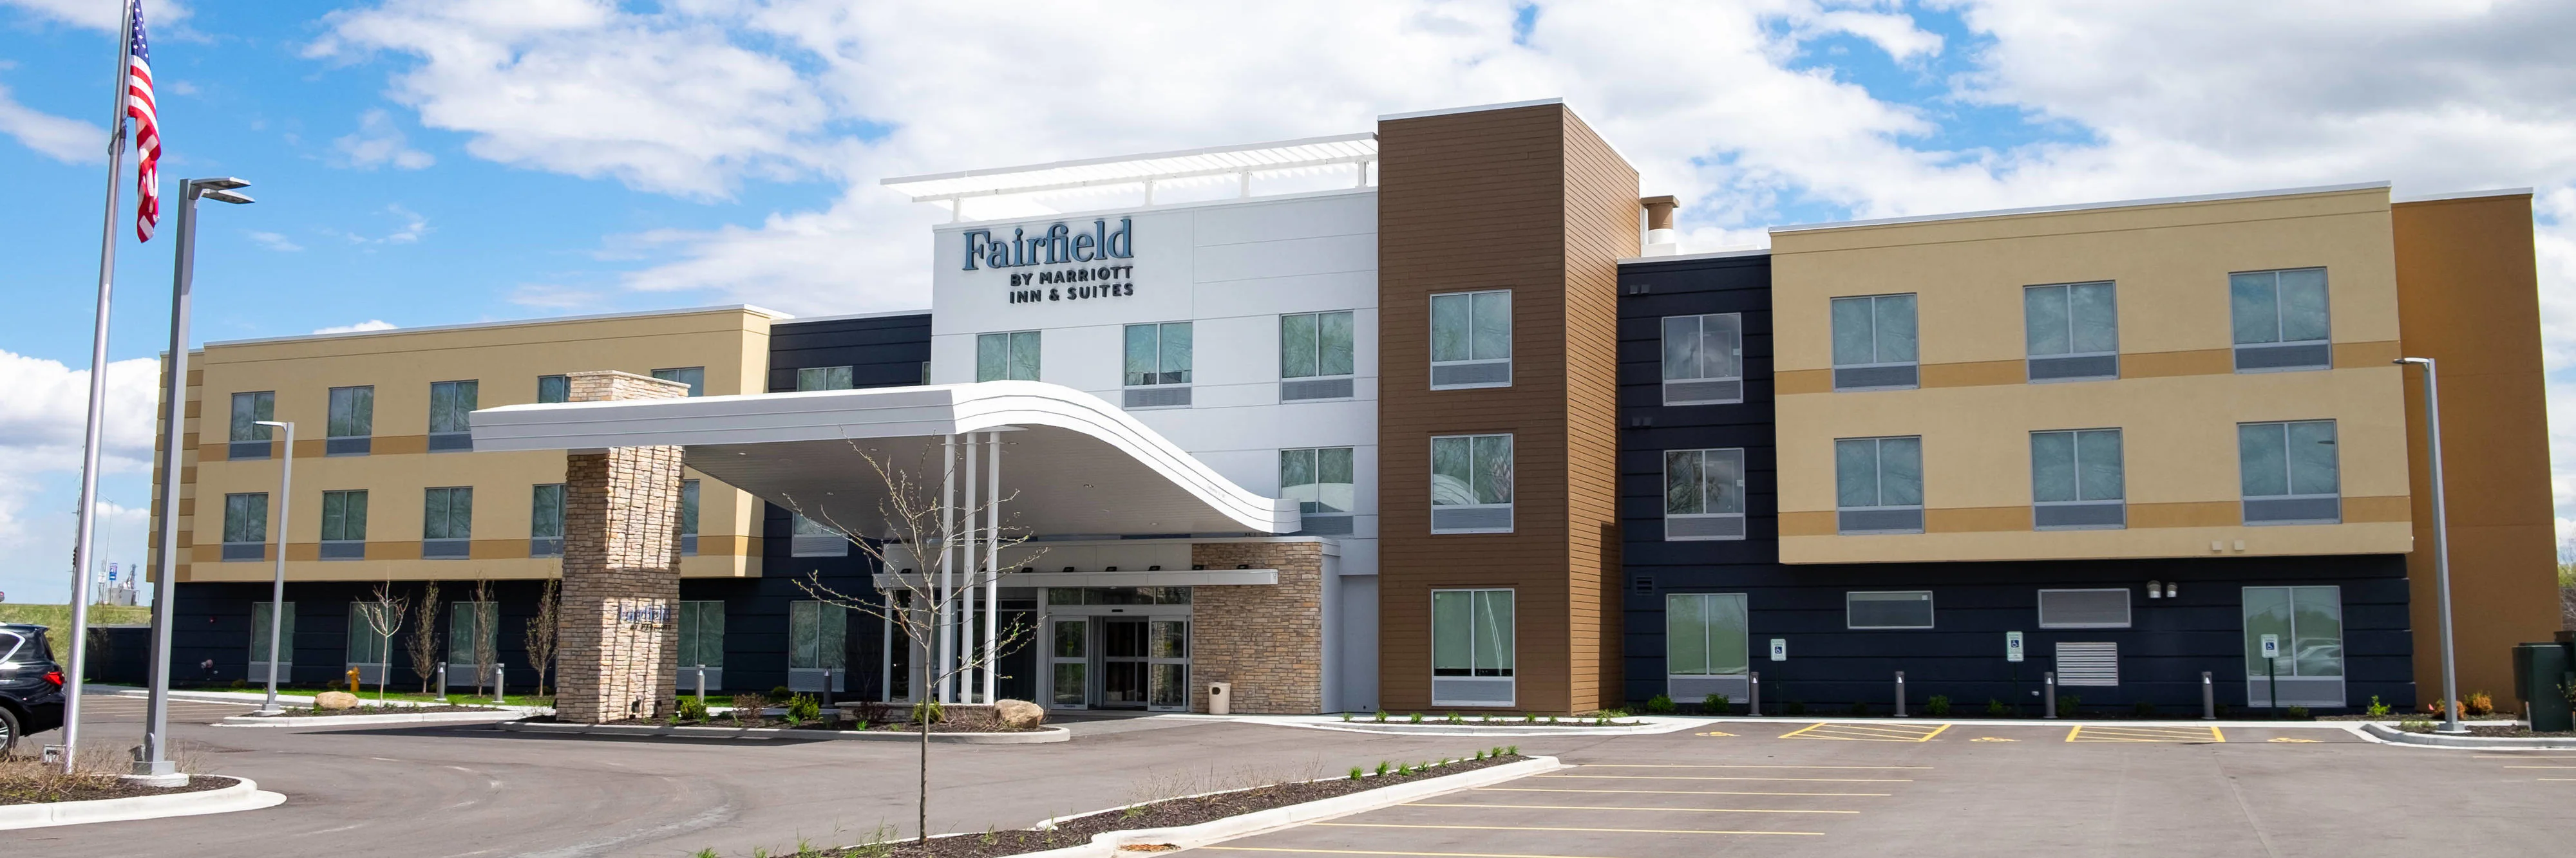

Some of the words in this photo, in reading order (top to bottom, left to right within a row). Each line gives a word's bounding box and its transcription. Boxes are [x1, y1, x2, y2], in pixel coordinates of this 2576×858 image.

[962, 219, 1134, 270] Fairfield
[1010, 273, 1033, 286] BY
[1039, 266, 1133, 285] MARRIOTT
[1009, 290, 1041, 304] INN
[1048, 288, 1060, 301] &
[1066, 283, 1133, 300] SUITES
